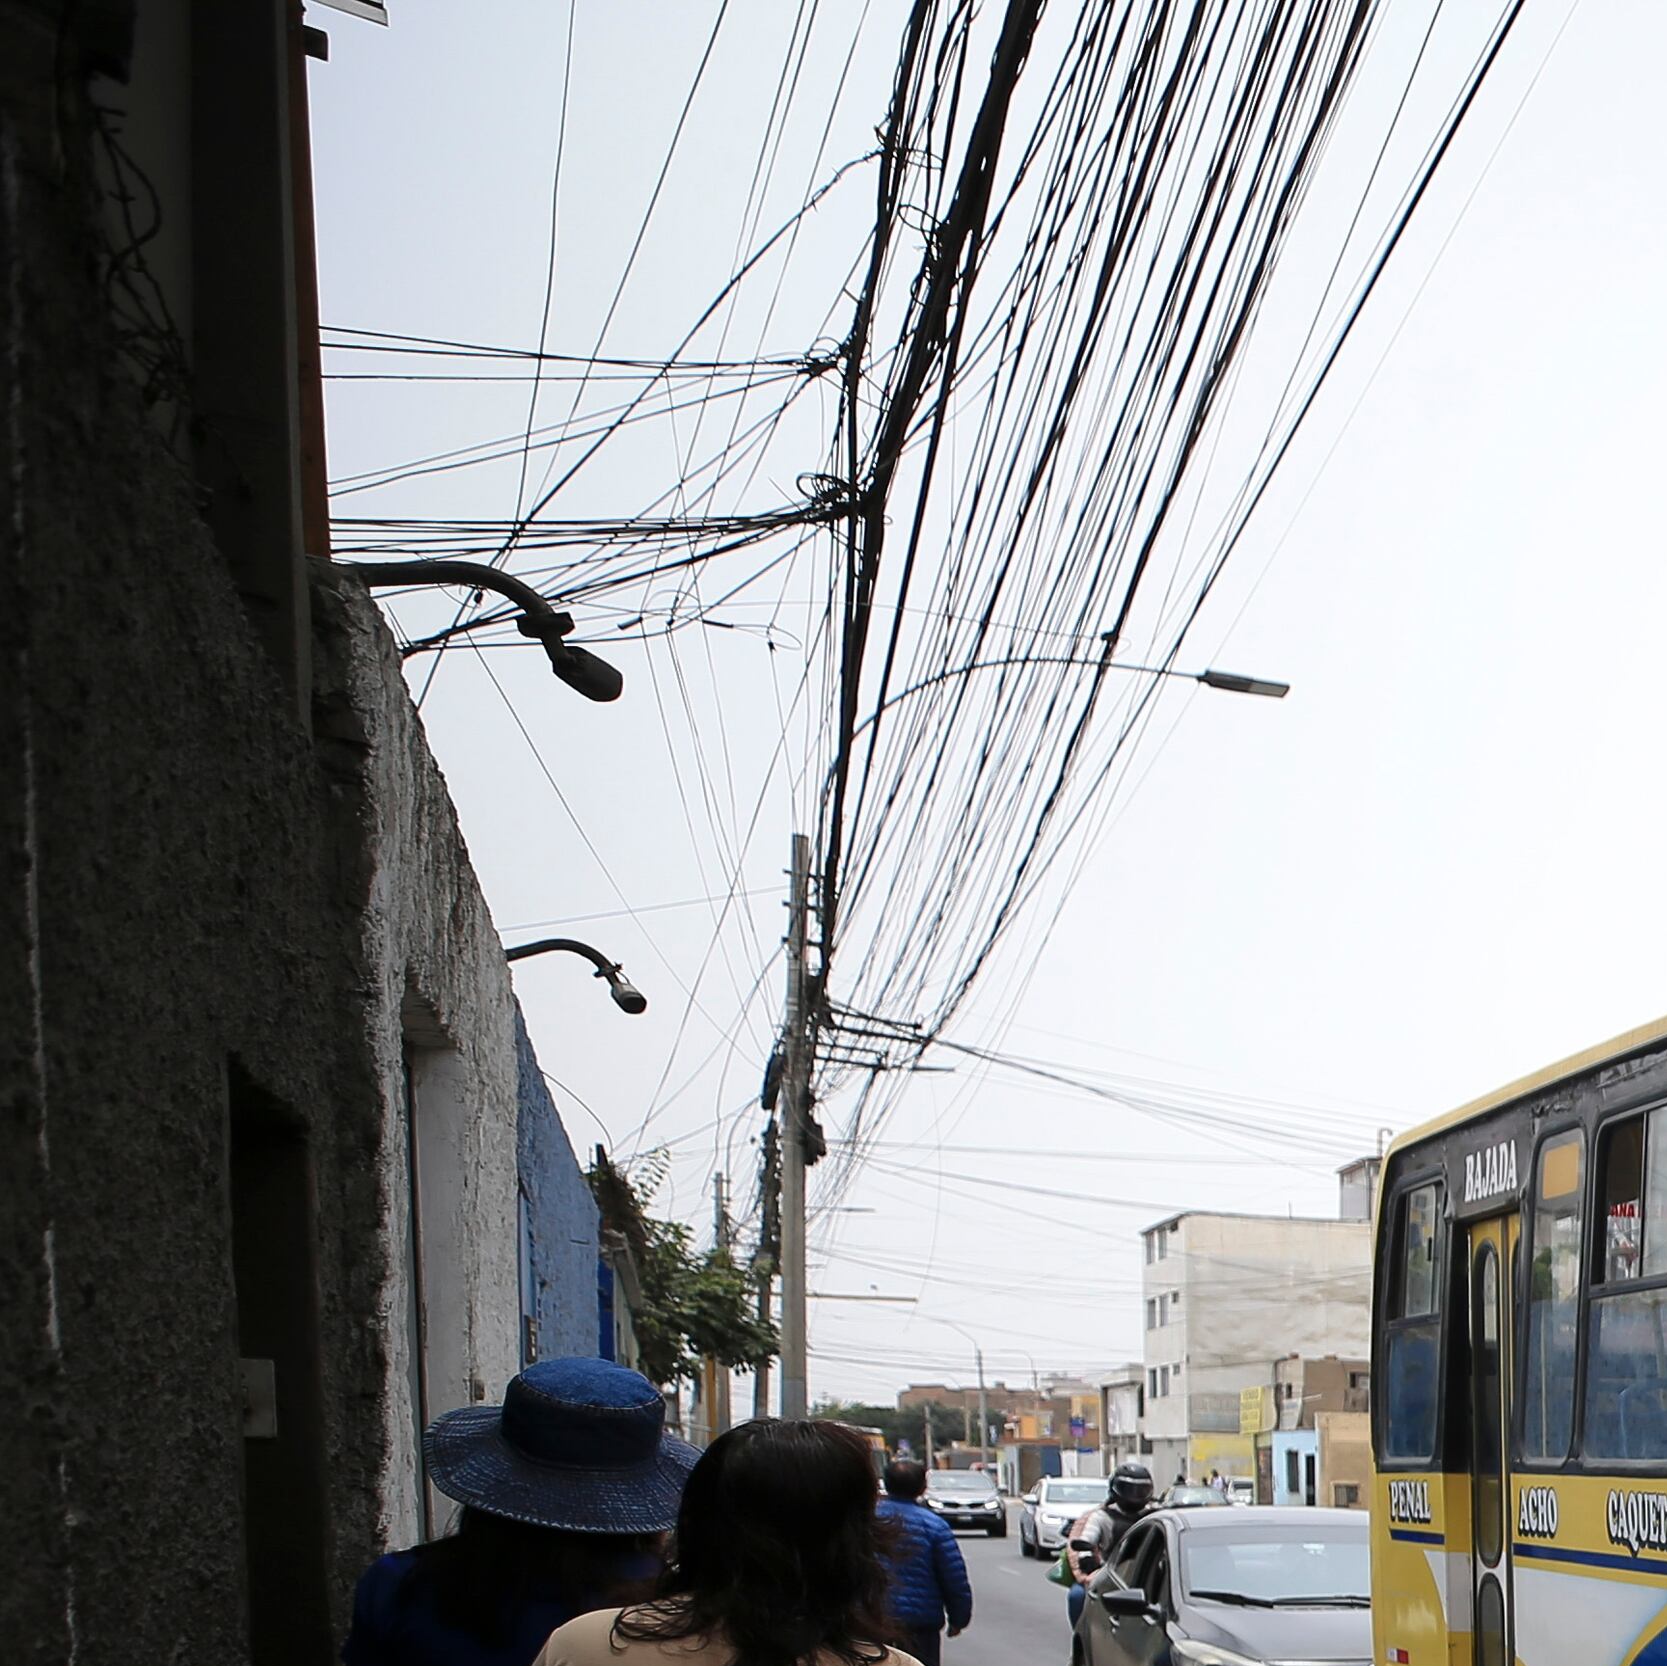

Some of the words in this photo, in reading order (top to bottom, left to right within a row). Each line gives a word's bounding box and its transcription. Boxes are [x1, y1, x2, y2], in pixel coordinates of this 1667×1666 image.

[1464, 1140, 1517, 1203] BAJADA
[1389, 1480, 1432, 1524] PENAL
[1518, 1487, 1559, 1538] ACHO
